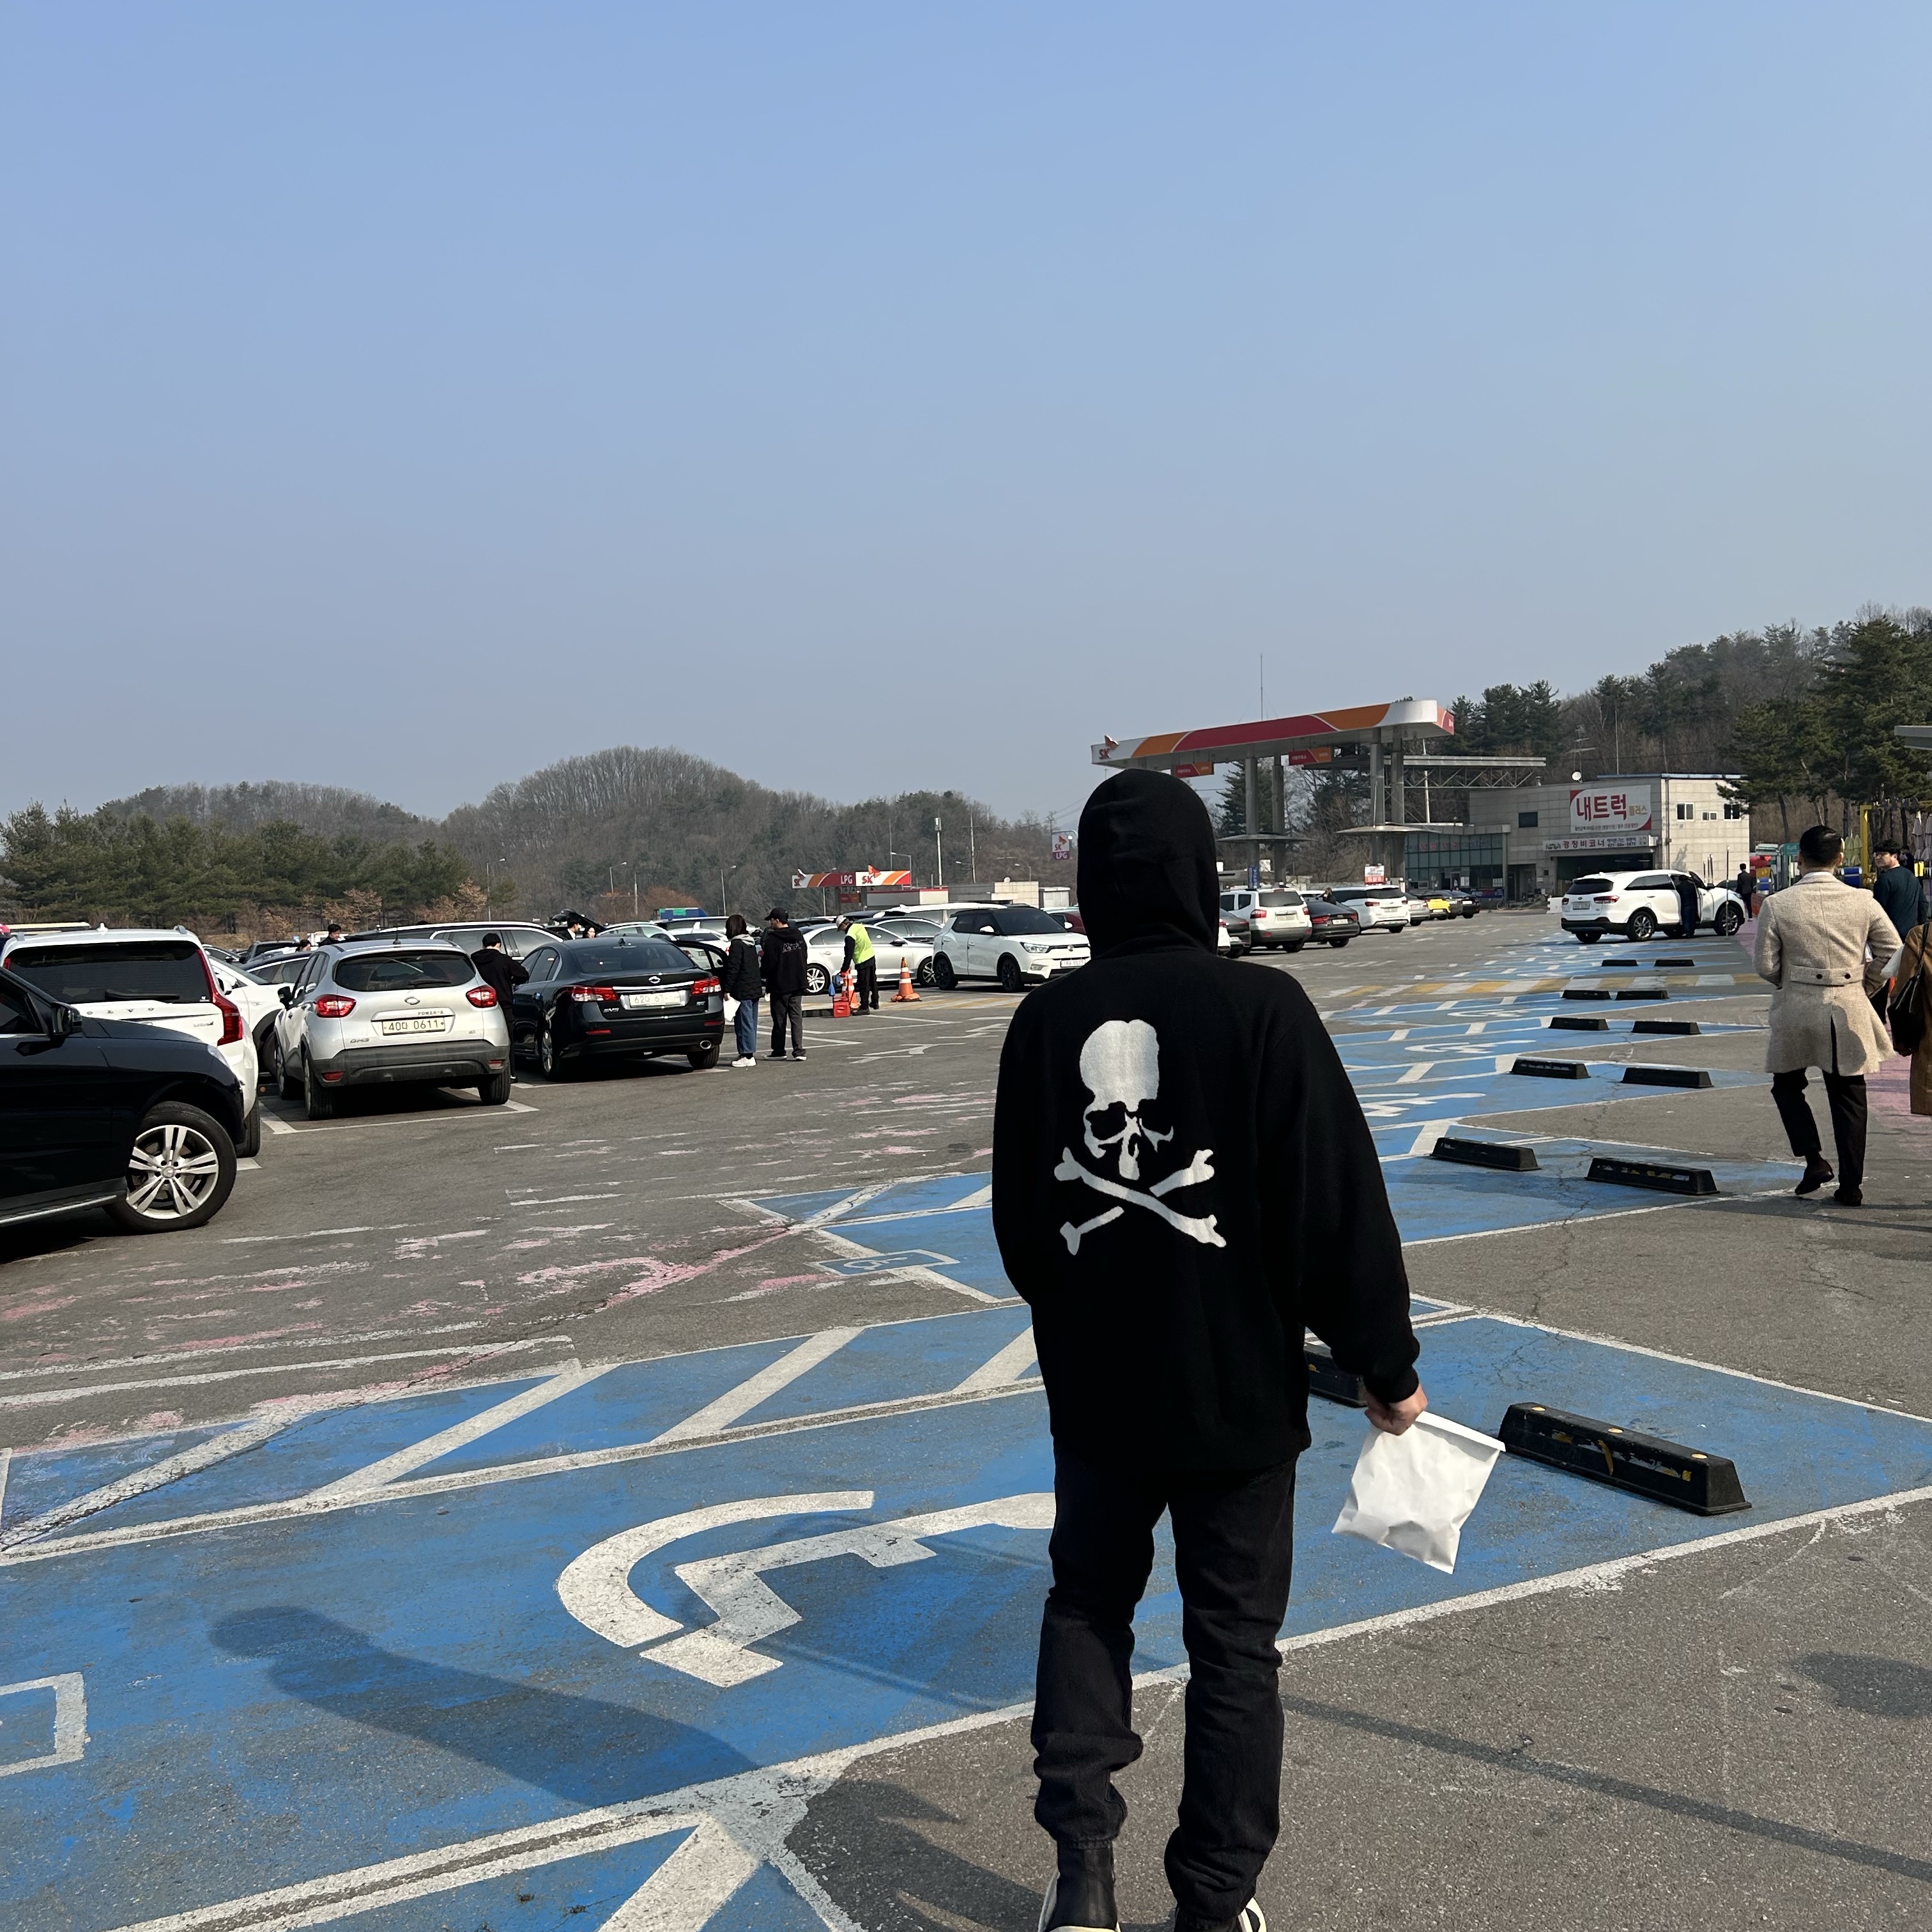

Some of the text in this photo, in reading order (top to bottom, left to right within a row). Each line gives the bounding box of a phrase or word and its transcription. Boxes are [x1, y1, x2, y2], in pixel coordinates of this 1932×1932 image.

[1099, 748, 1110, 759] SK
[1576, 794, 1627, 822] 내트럭
[840, 875, 853, 885] LPG
[861, 875, 873, 885] SK
[413, 1019, 438, 1030] 0611
